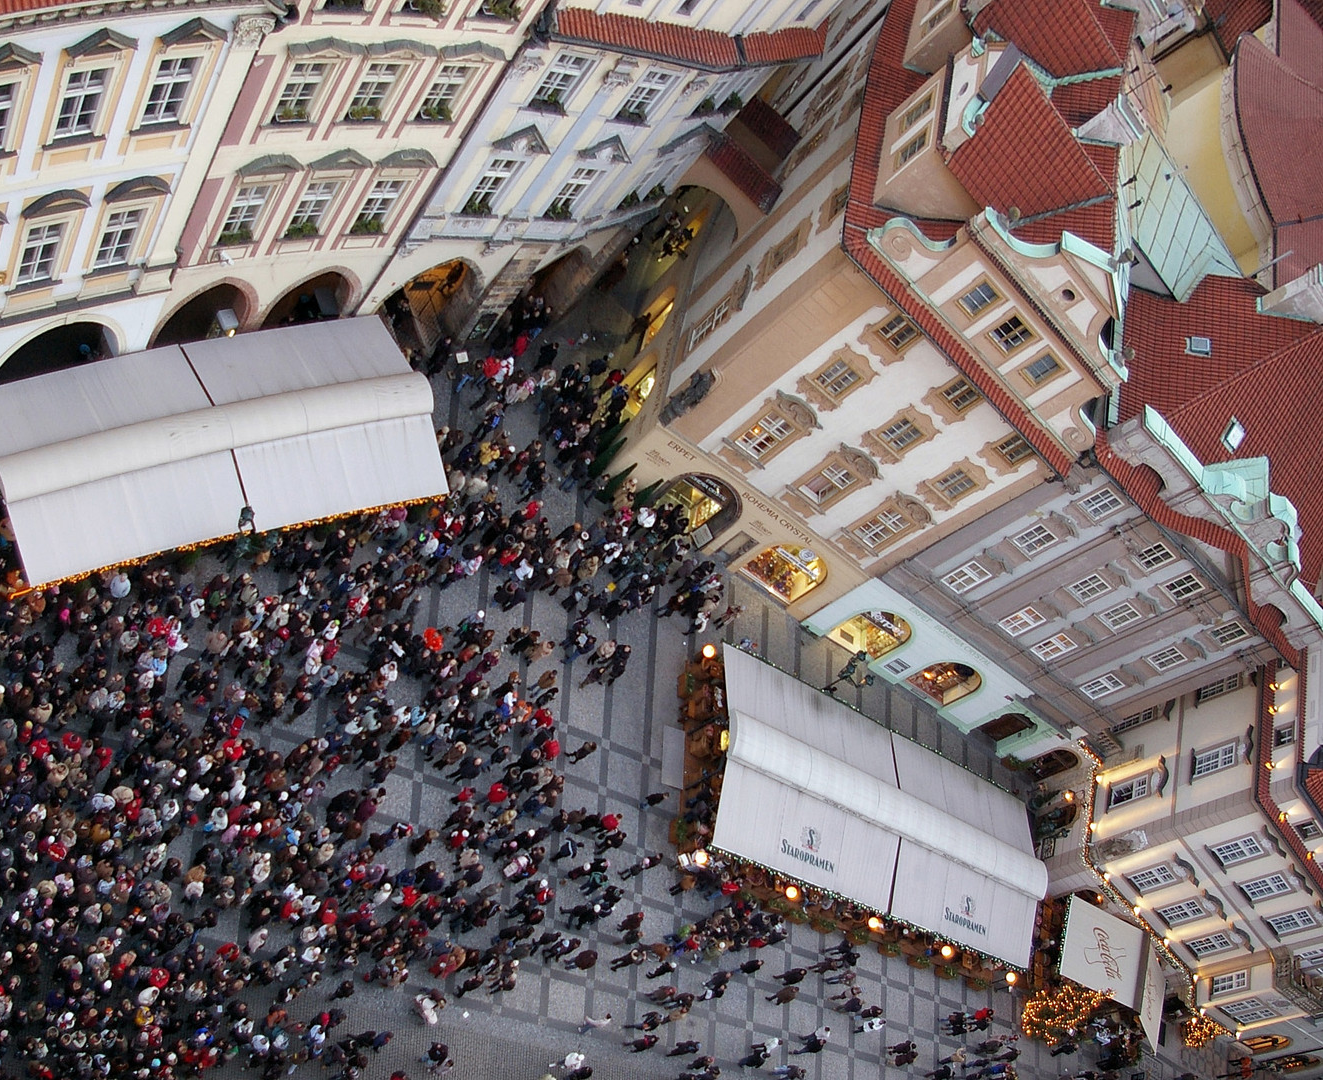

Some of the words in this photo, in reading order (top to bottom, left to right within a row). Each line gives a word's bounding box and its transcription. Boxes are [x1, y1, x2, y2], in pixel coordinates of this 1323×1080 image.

[667, 440, 697, 461] ERPET
[742, 491, 779, 520] BOHEMIA
[779, 518, 813, 546] CRYSTAL
[780, 838, 835, 874] STAROPRAMEN
[944, 906, 987, 936] STAROPRAMEN
